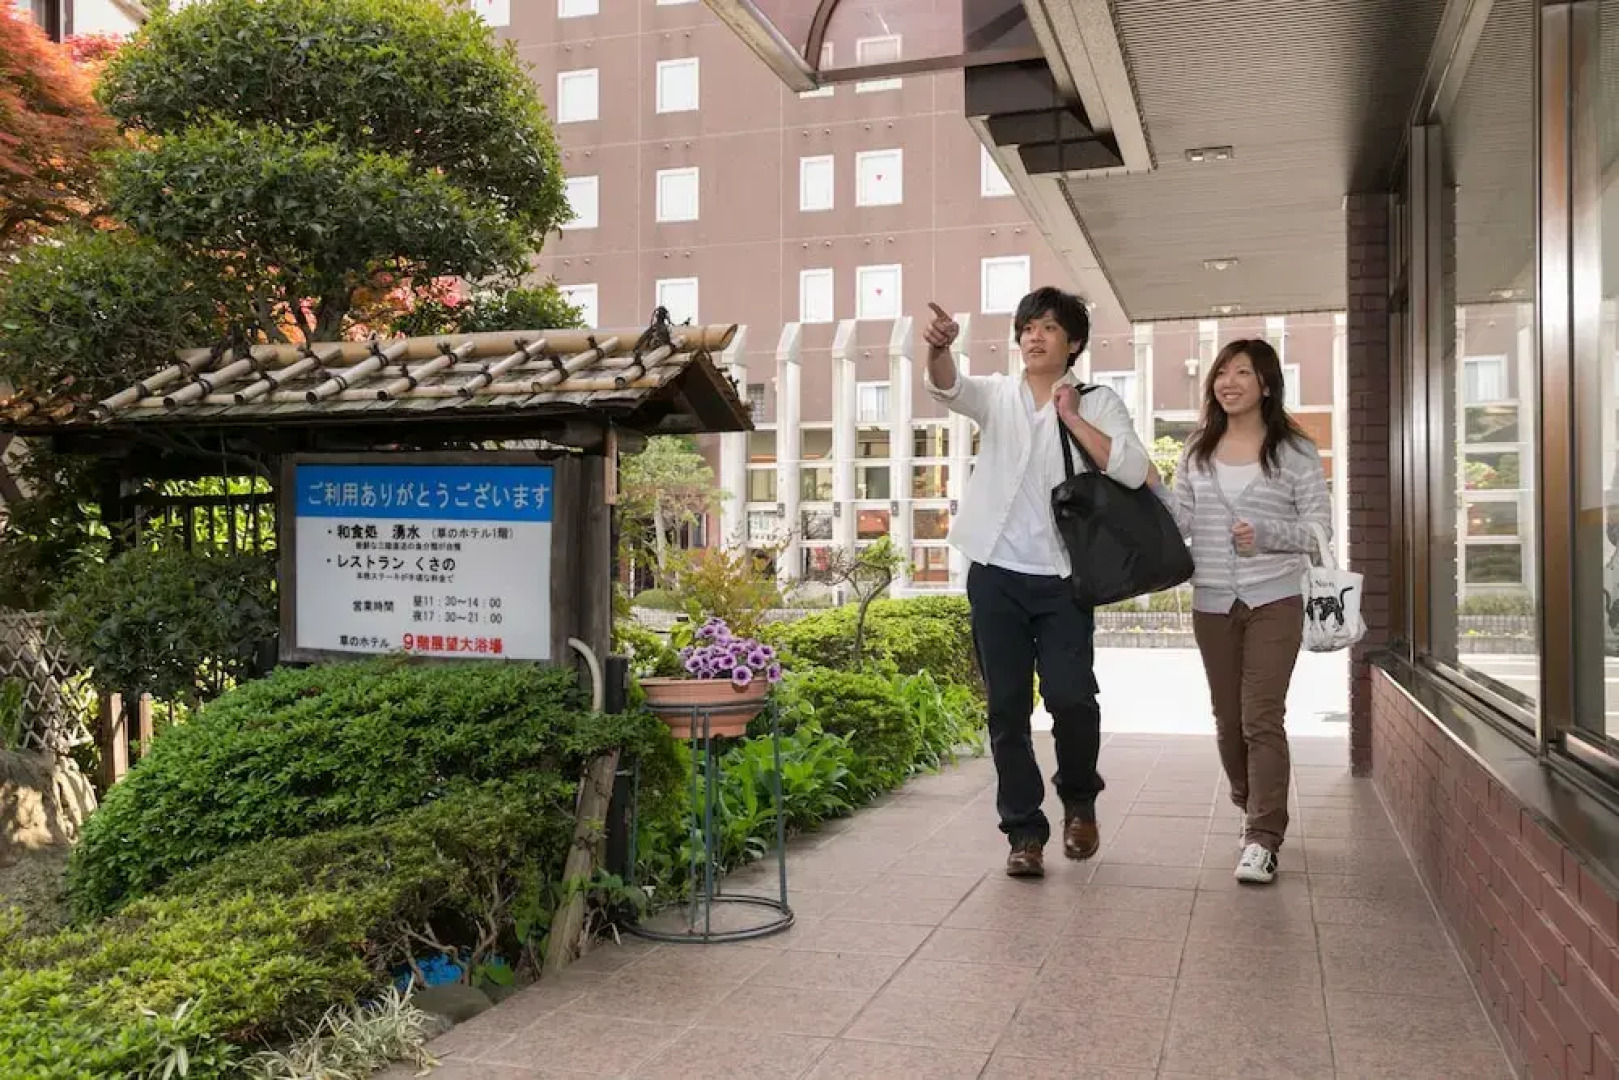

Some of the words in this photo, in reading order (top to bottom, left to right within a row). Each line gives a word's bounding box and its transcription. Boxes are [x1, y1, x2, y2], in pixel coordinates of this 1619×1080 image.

[308, 482, 550, 509] ご利用ありがとうございます
[336, 524, 379, 539] 和食処
[392, 524, 422, 539] 湧水
[337, 555, 405, 571] レストラン
[415, 556, 456, 571] くさの
[353, 600, 394, 613] 営業時間
[339, 635, 390, 648] 草のホテル
